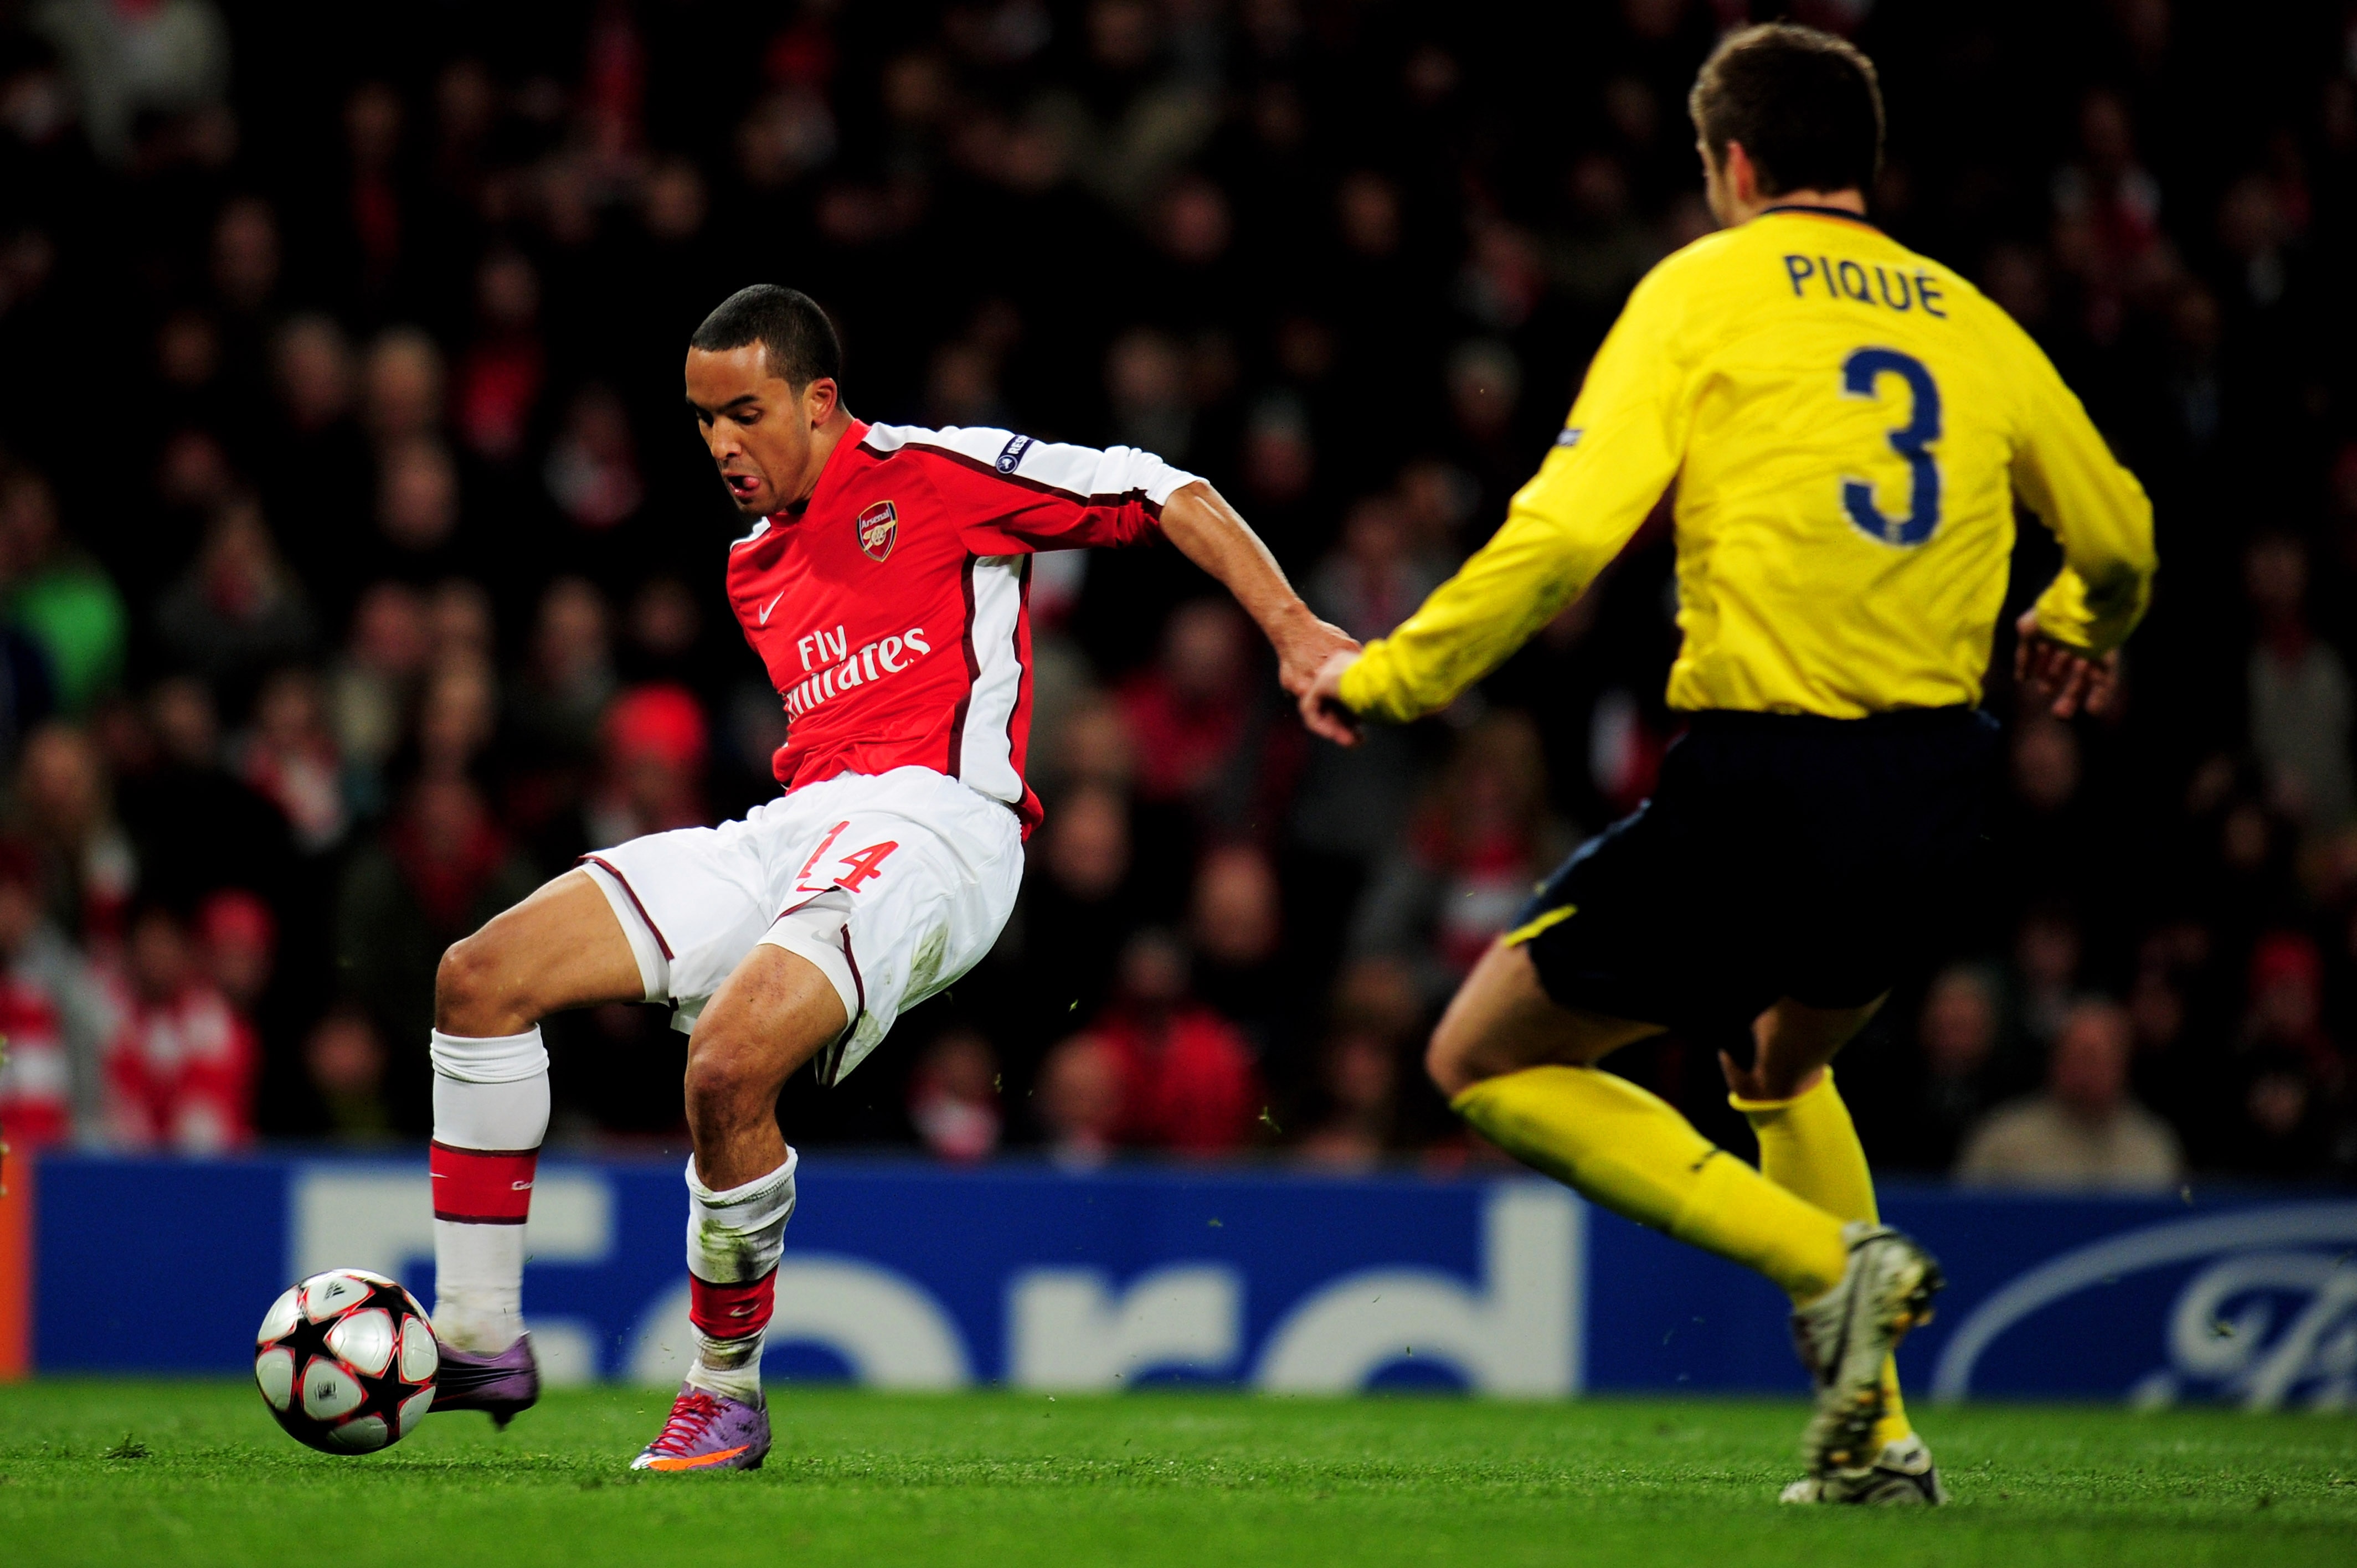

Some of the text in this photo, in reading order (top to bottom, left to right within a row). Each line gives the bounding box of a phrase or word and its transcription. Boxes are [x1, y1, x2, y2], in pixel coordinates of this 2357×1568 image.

[1839, 345, 1943, 549] 3
[861, 509, 890, 529] Arsenal
[786, 628, 931, 724] mirates
[797, 625, 847, 672] Fly
[796, 821, 899, 893] 14
